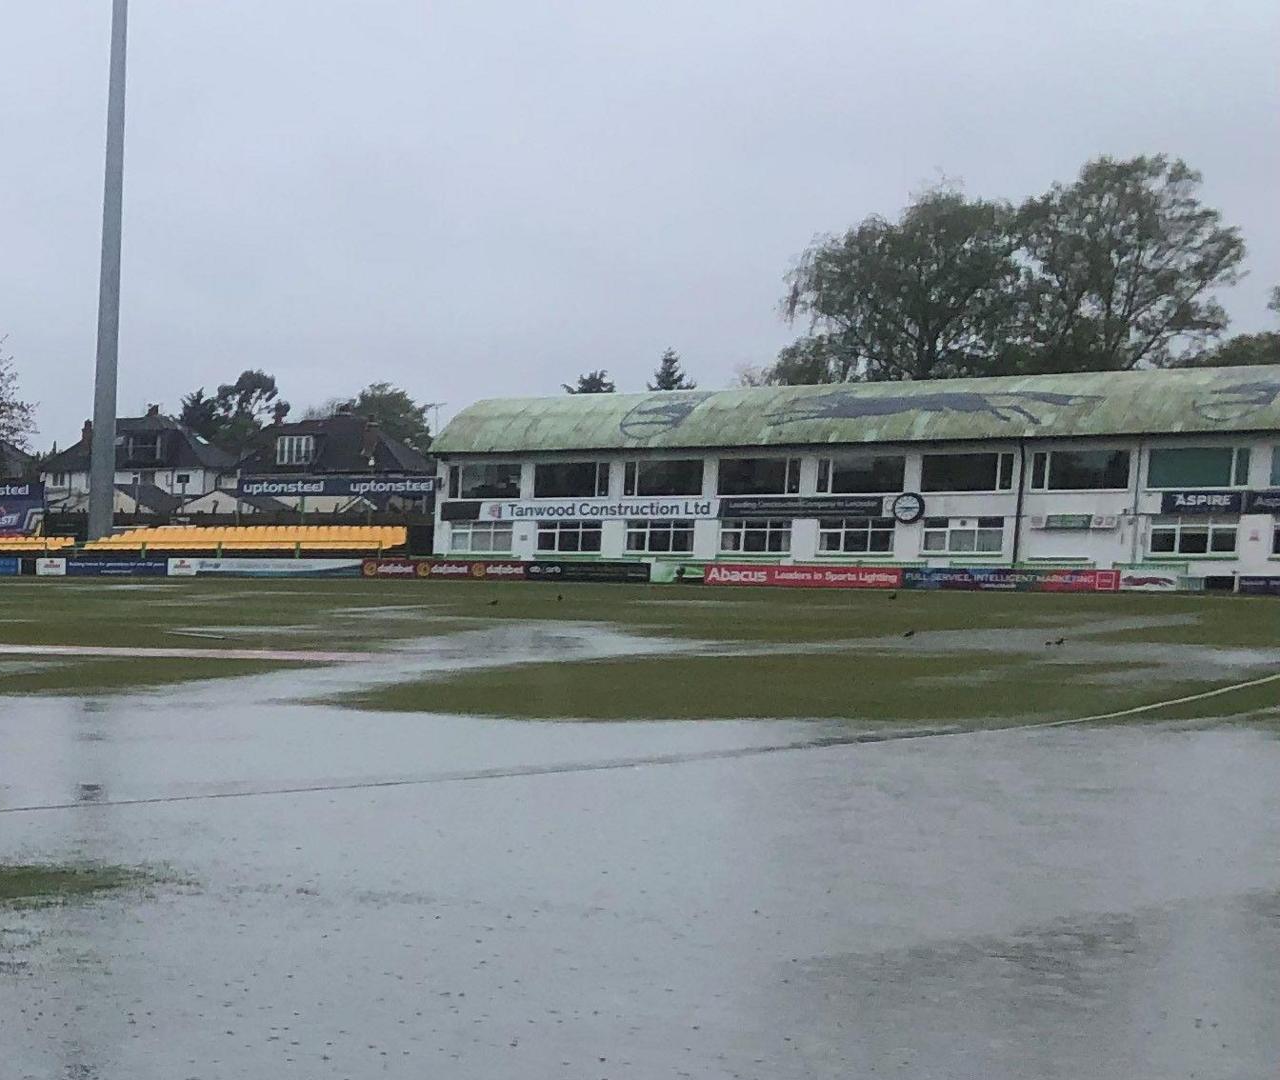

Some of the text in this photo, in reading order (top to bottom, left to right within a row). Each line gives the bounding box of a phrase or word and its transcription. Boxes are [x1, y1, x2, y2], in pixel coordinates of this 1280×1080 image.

[243, 481, 324, 495] uptonsteel
[350, 479, 433, 494] uptonsteel
[1173, 494, 1233, 506] ASPIRE
[508, 500, 711, 516] Tanwood Construction Ltd
[708, 567, 767, 582] Abacus
[775, 571, 811, 581] Leaders
[825, 571, 856, 583] Sports
[859, 572, 897, 584] Lighting
[905, 573, 927, 581] FULL
[974, 574, 1033, 582] INTELLIGENT
[1036, 575, 1095, 583] MARKETING
